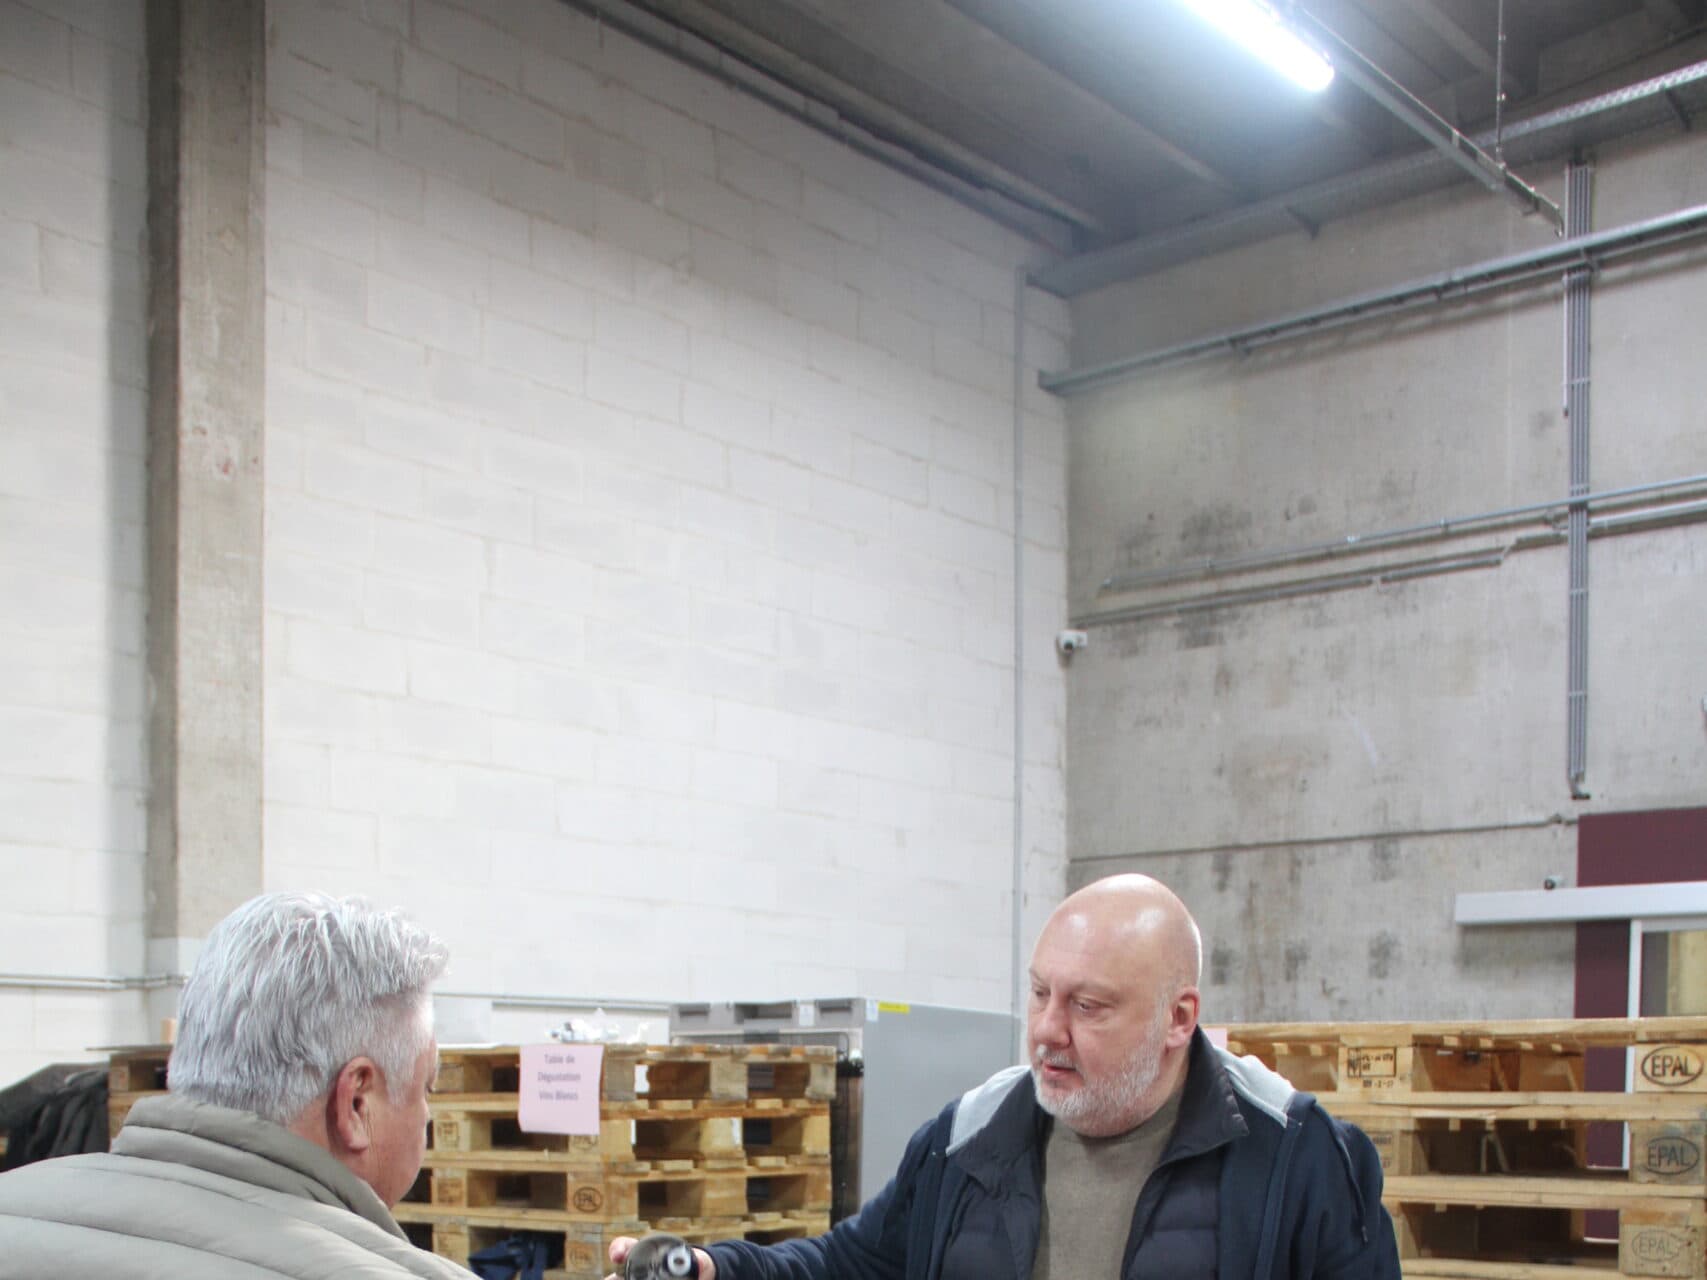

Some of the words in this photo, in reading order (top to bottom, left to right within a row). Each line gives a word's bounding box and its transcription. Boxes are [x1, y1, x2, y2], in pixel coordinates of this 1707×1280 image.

[1650, 1055, 1697, 1077] EPAL
[1647, 1145, 1693, 1168] EPAL
[1639, 1233, 1674, 1255] EPAL
